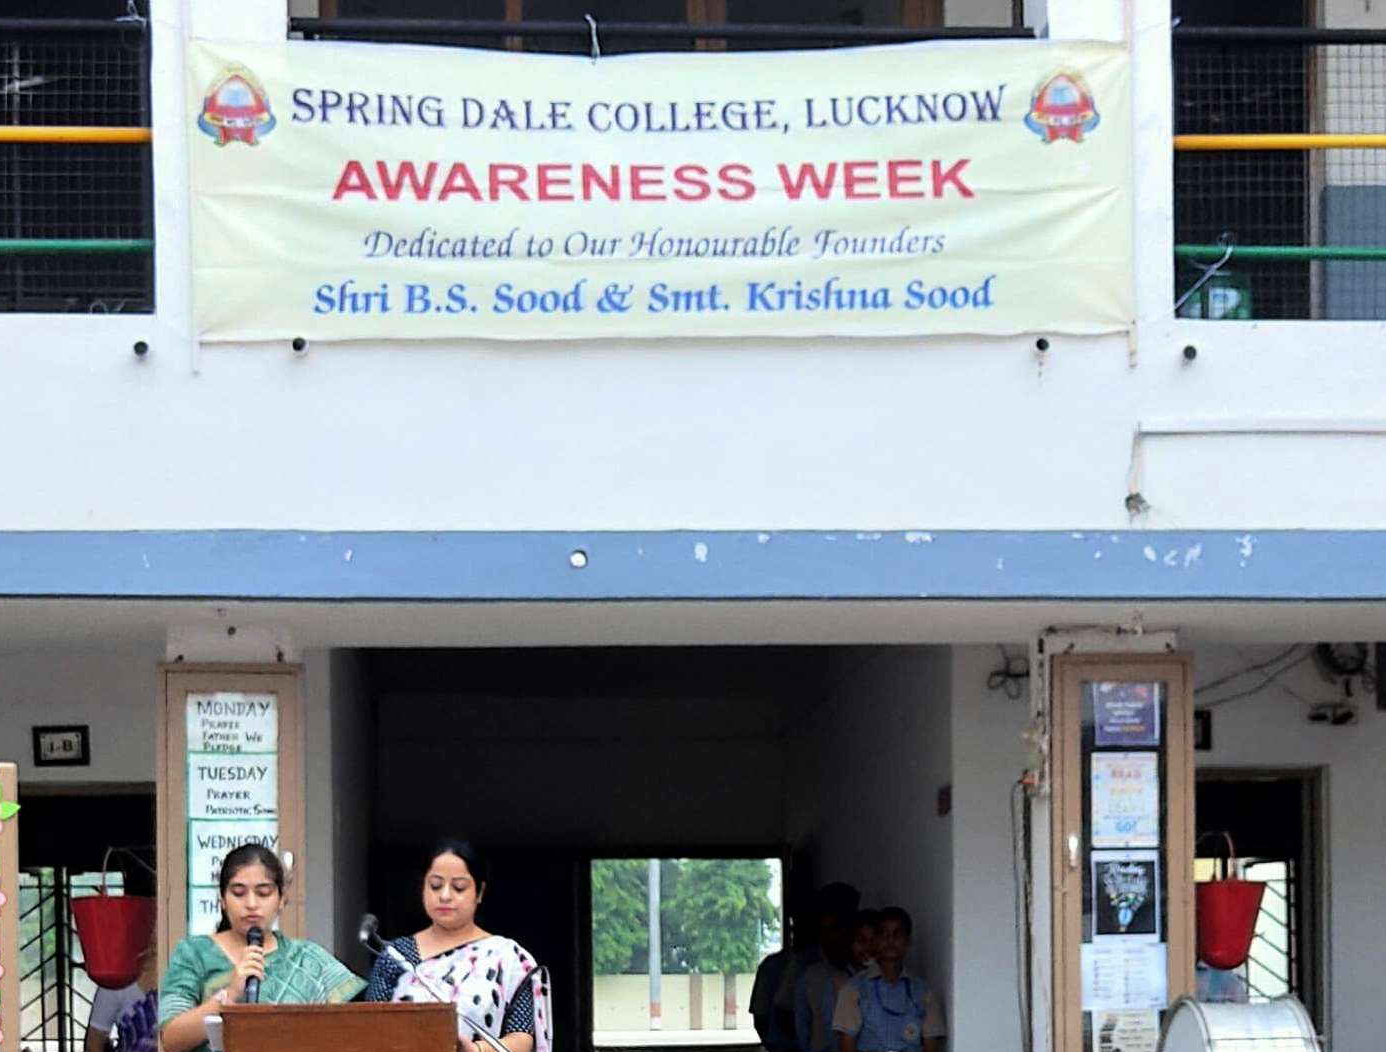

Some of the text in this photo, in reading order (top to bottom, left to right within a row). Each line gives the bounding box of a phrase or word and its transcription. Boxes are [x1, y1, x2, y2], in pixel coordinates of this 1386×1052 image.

[291, 85, 1006, 136] SPRING DALE COLLEGE, LUCKNOW
[332, 157, 975, 202] AWARENESS WEEK
[363, 226, 946, 261] Dedicated to Our Honourable Founders
[313, 275, 995, 316] Shri B.S. Sood & Smt. Krishna Sood
[197, 701, 270, 716] MONDAY
[197, 766, 269, 781] TUESDAY
[207, 789, 251, 800] PRAYER
